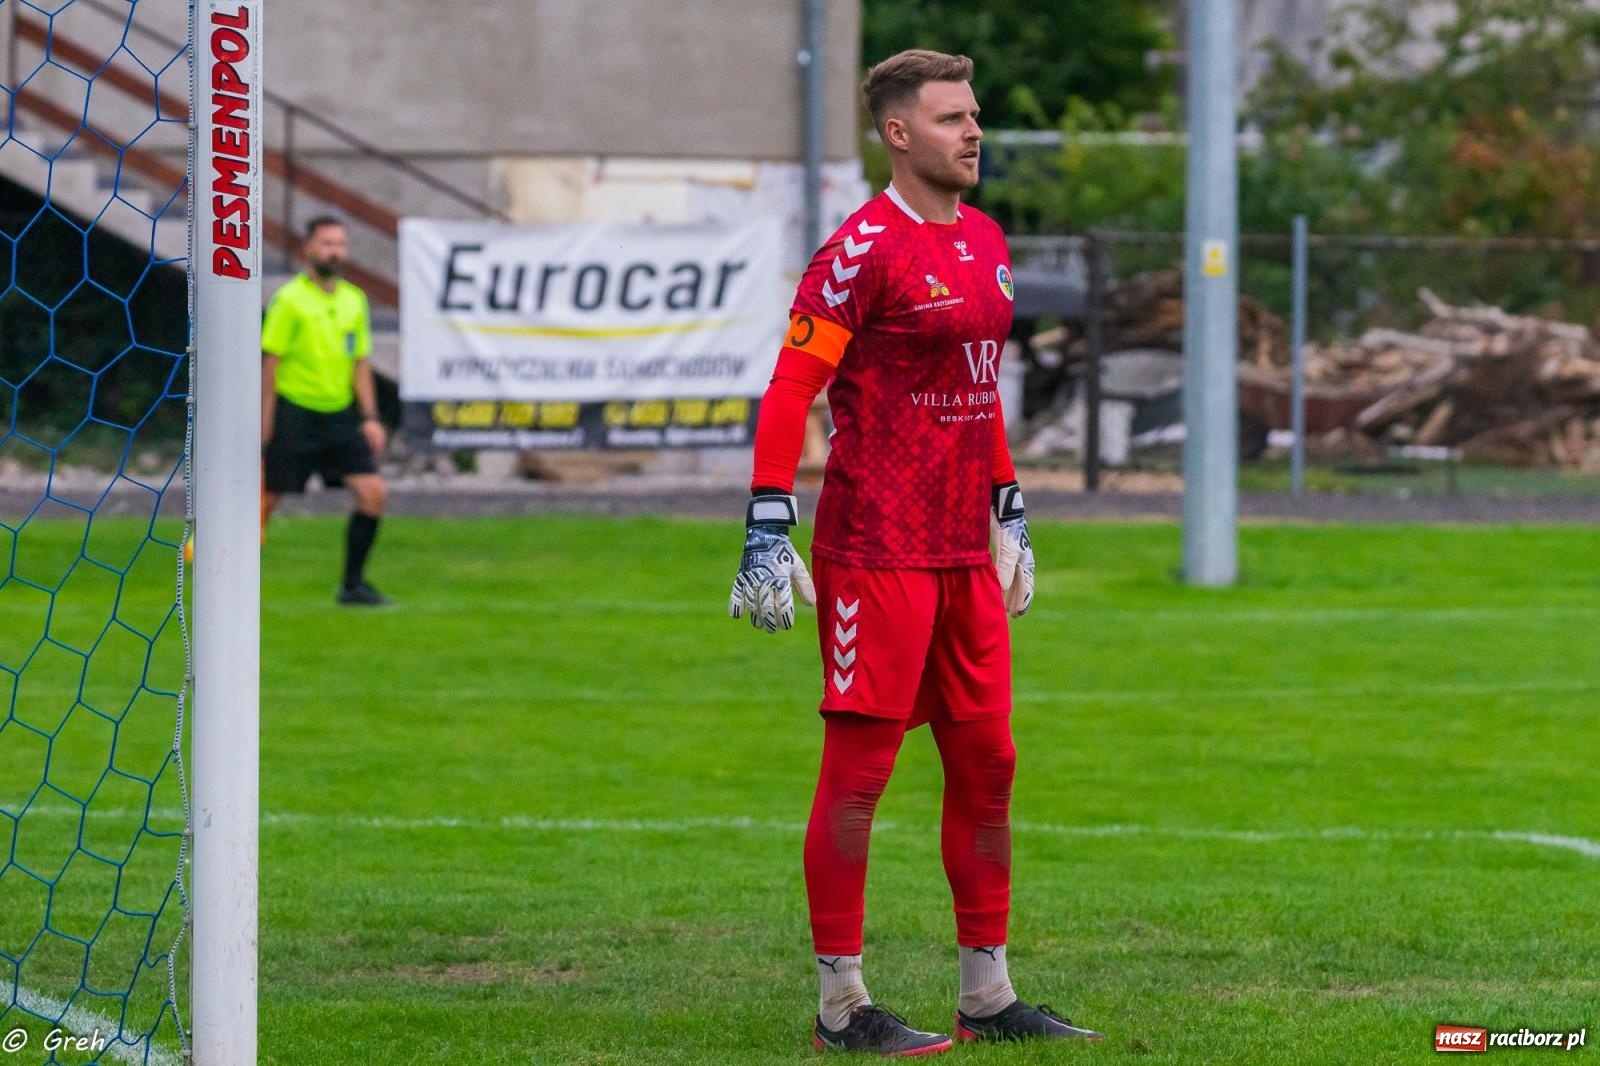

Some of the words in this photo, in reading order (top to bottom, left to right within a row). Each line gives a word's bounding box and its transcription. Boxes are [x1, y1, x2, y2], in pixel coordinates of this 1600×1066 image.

[210, 5, 250, 280] PESMENPOL
[438, 243, 747, 312] Eurocar
[961, 339, 998, 385] VR
[910, 392, 963, 407] VILLA
